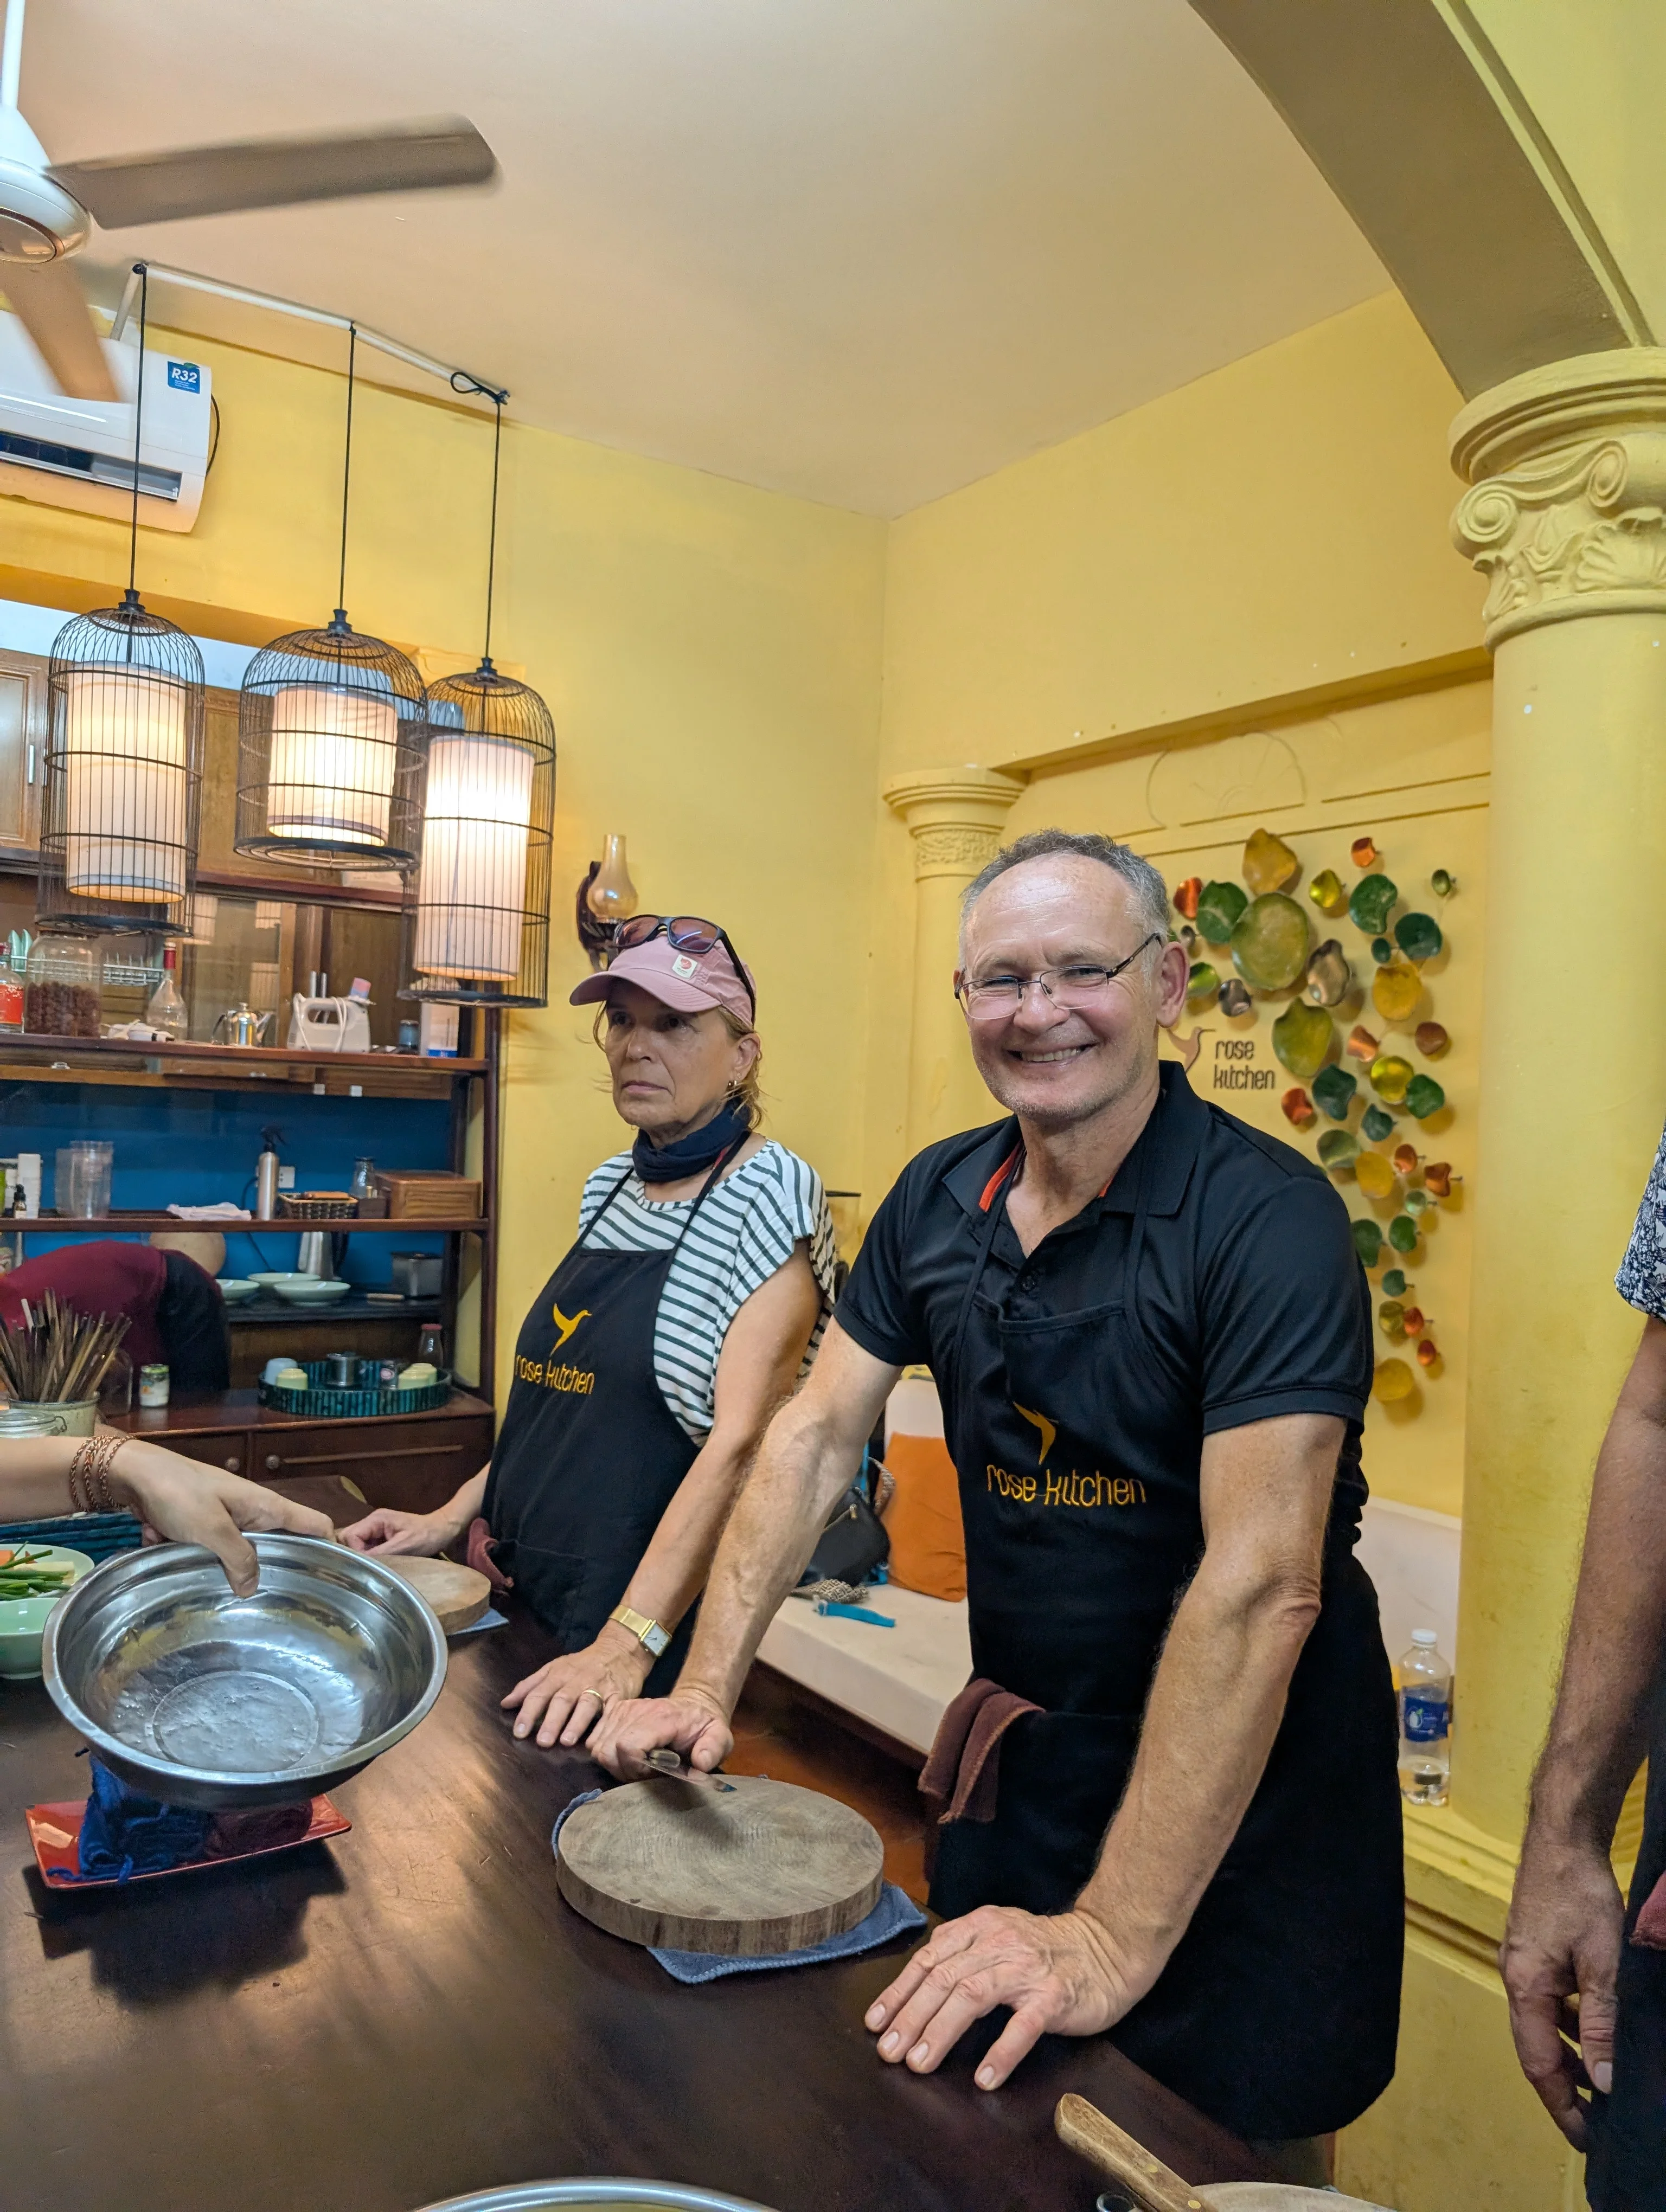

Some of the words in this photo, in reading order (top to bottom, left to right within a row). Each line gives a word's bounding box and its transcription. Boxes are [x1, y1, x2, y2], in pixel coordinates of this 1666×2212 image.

[171, 368, 197, 383] R32
[1215, 1040, 1254, 1059] rose
[1214, 1064, 1274, 1089] kitchen
[515, 1354, 542, 1384] rose
[544, 1359, 595, 1394] kitchen
[986, 1464, 1036, 1502] rose
[1044, 1469, 1146, 1507] kitchen
